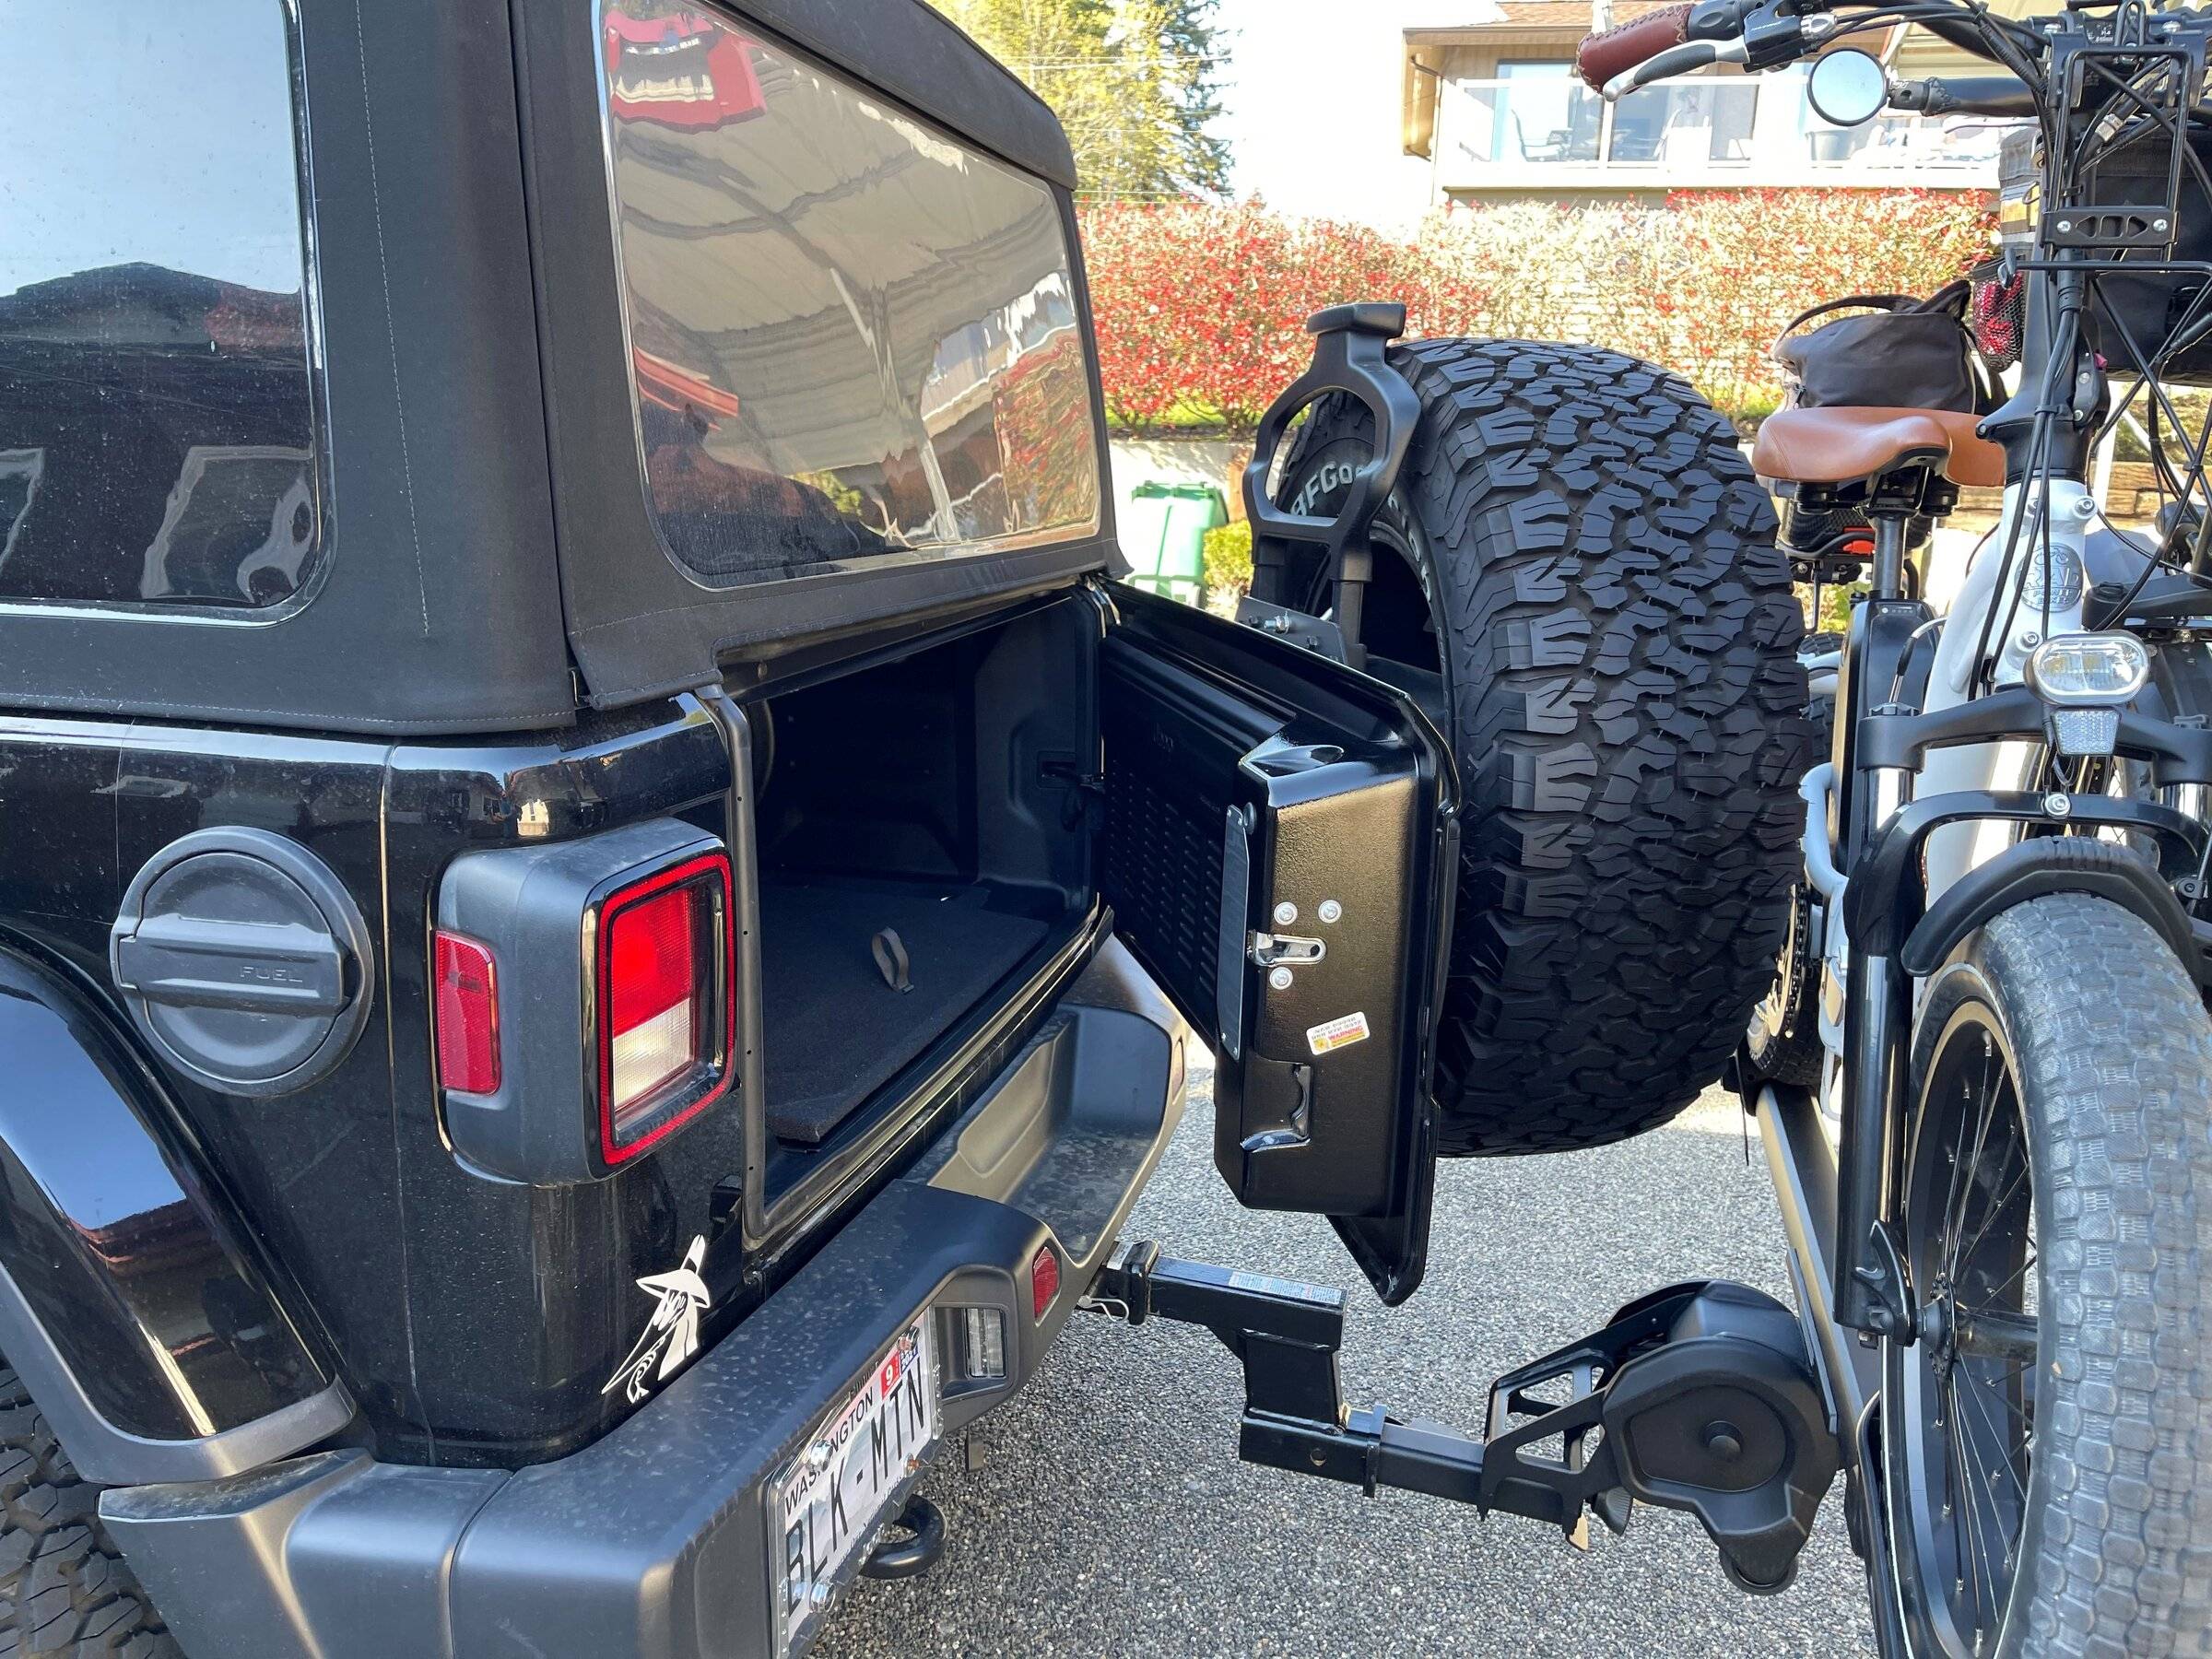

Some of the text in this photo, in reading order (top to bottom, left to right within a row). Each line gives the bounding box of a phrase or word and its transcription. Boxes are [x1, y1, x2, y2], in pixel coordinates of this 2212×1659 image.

[241, 966, 303, 982] FUEL
[1328, 1026, 1363, 1041] WARNING
[886, 1365, 893, 1385] 9
[785, 1386, 874, 1516] WASNGTON
